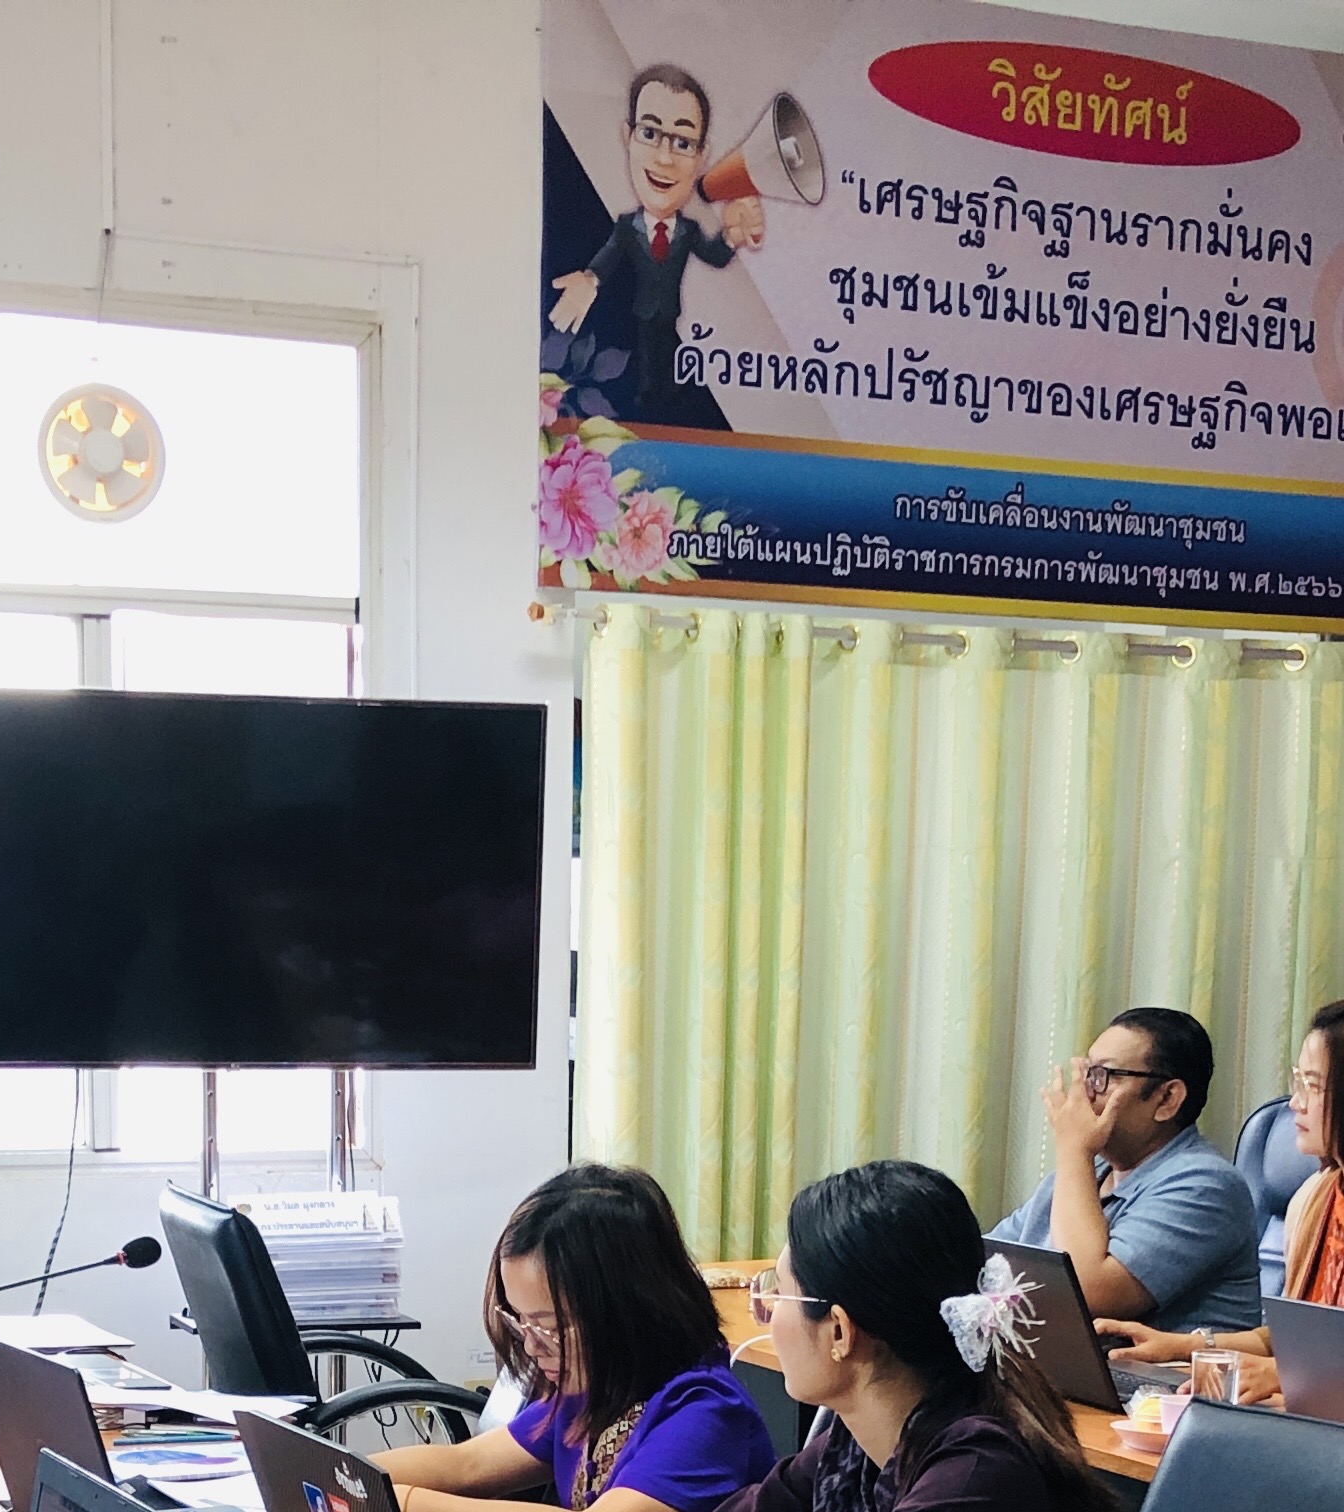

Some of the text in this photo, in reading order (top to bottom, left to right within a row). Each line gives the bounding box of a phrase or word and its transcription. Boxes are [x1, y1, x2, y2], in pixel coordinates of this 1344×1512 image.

[988, 57, 1193, 147] วิสัยทัศน์
[842, 168, 1314, 268] “เศรษฐกิจฐานรากมั่นคง
[829, 264, 1315, 354] ชุมชนเข้มแข็งอย่างยั่งยืน
[894, 483, 1247, 546] การขับเคลื่อนงานพัฒนาชุมชน
[667, 523, 1219, 599] ภายใต้แผนปฏิบัติราชการกรมการพัฒนาชุมชน
